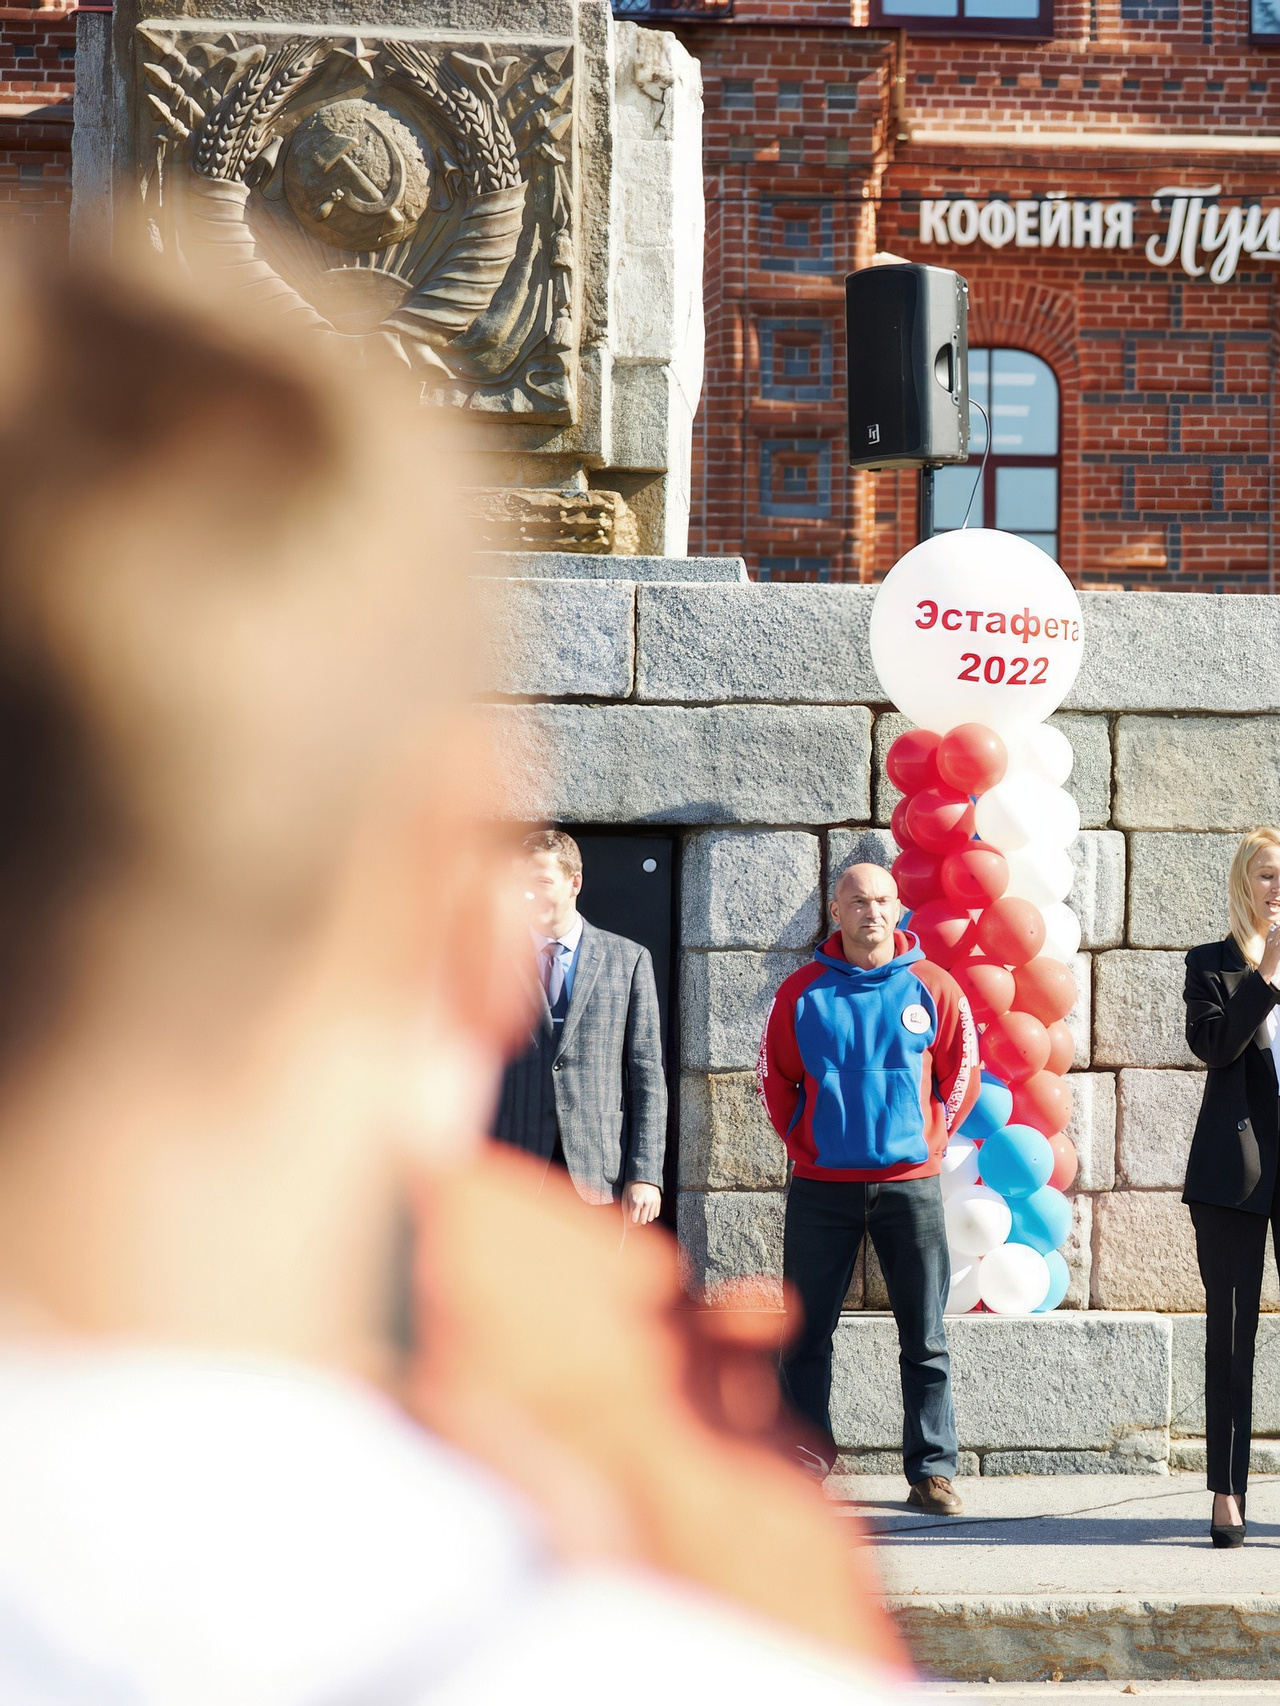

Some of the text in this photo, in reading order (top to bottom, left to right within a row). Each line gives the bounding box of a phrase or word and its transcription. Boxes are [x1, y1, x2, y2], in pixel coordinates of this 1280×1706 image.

[919, 190, 1134, 249] КОФЕЙНЯ
[914, 599, 1080, 644] Эстафета
[956, 652, 1050, 686] 2022
